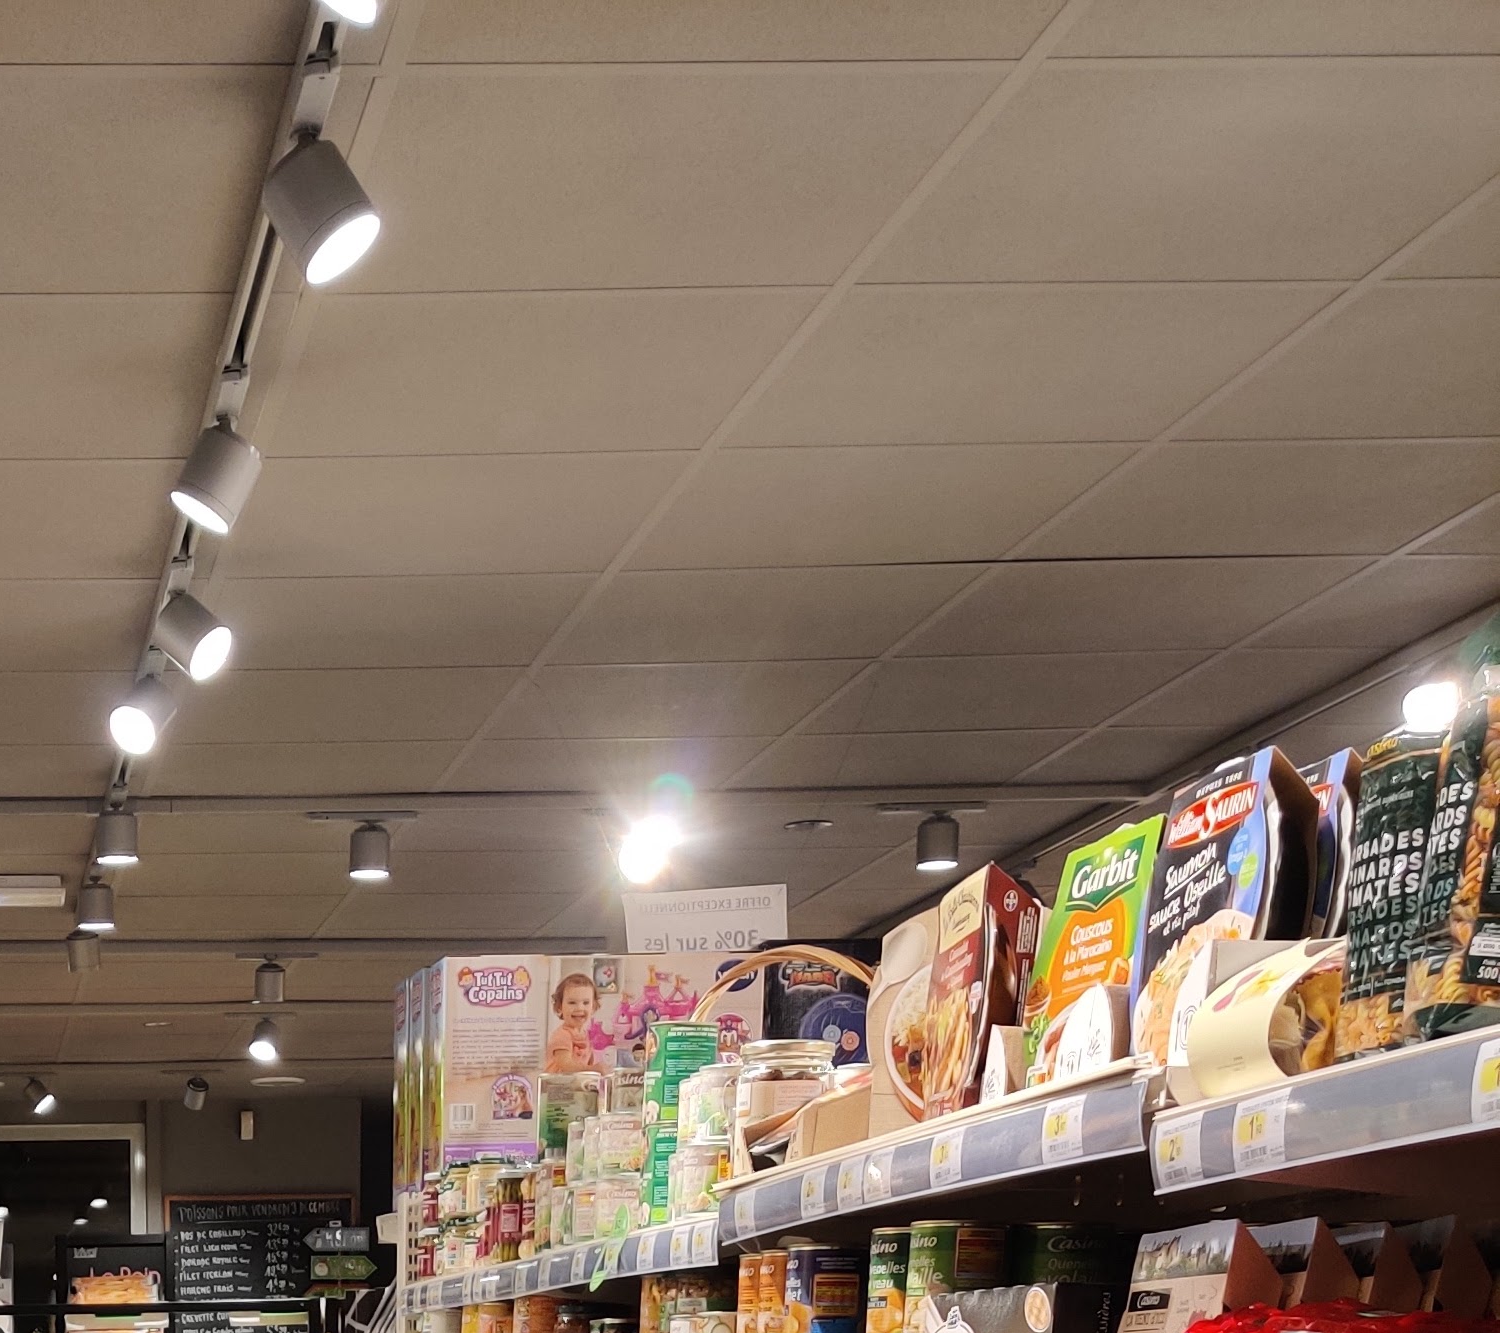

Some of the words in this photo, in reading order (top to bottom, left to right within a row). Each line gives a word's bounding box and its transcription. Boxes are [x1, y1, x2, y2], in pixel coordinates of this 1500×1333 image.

[1167, 809, 1205, 846] William
[1199, 785, 1259, 840] SAURIN
[1071, 848, 1138, 899] Garbit
[1164, 841, 1217, 893] Saumon
[1147, 901, 1181, 934] sauce
[1182, 860, 1227, 905] Oseille
[468, 984, 524, 1004] Copains
[179, 1205, 223, 1222] POISSONS
[226, 1204, 248, 1218] POUR
